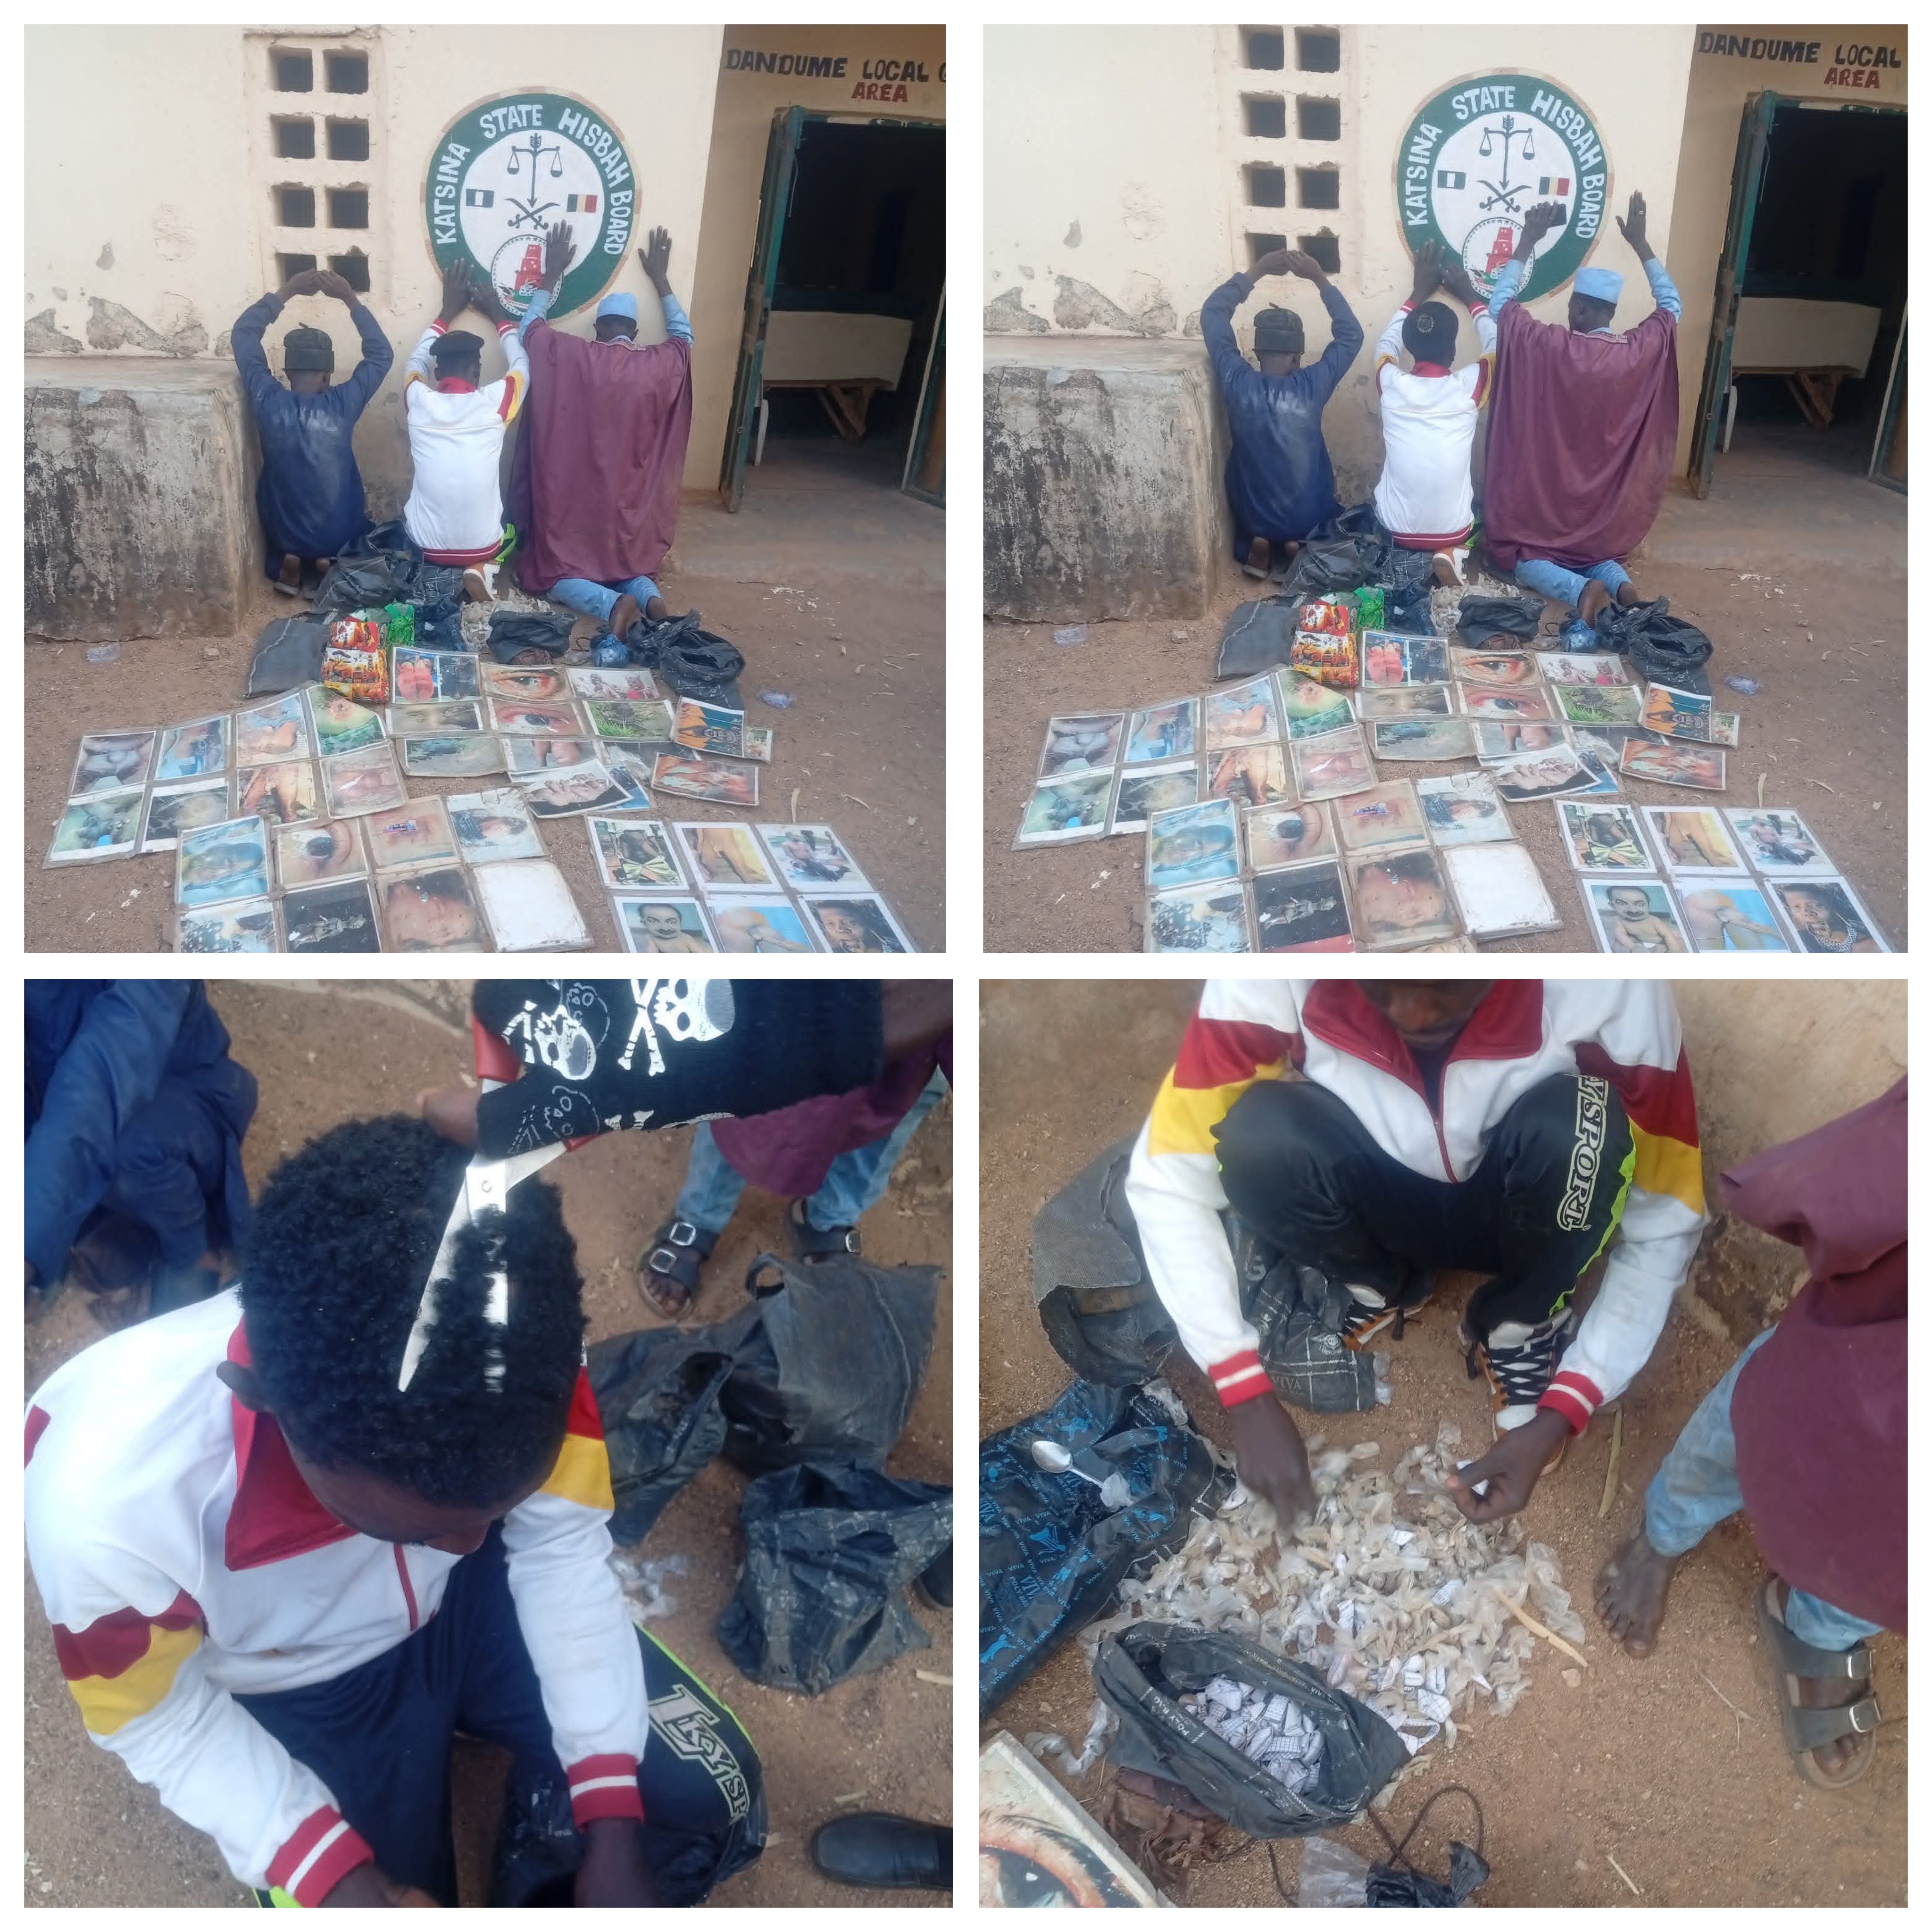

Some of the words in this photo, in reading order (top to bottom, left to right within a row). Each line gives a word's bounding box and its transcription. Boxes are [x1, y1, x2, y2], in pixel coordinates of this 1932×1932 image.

[1699, 32, 1821, 63] DANDUME
[1834, 44, 1901, 68] LOCAL
[725, 49, 848, 78] DANDUME
[862, 59, 929, 83] LOCAL
[1824, 67, 1880, 89] AREA
[851, 82, 908, 102] AREA
[1405, 123, 1443, 226] KATSINA
[1452, 86, 1516, 120] STATE
[1530, 89, 1602, 171] HISBAH
[1575, 173, 1605, 239] BOARD
[433, 142, 470, 245] KATSINA
[480, 104, 543, 139] STATE
[558, 108, 630, 188] HISBAH
[603, 189, 633, 256] BOARD
[1035, 1511, 1051, 1519] VIVA
[1028, 1559, 1037, 1574] VIVA
[1010, 1576, 1023, 1594] POLY
[985, 1590, 995, 1604] VIVA
[994, 1607, 1004, 1622] VIVA
[1034, 1630, 1049, 1643] VIVA
[1017, 1637, 1032, 1652] VIVA
[1009, 1655, 1024, 1667] VIVA
[991, 1672, 1007, 1684] VIVA
